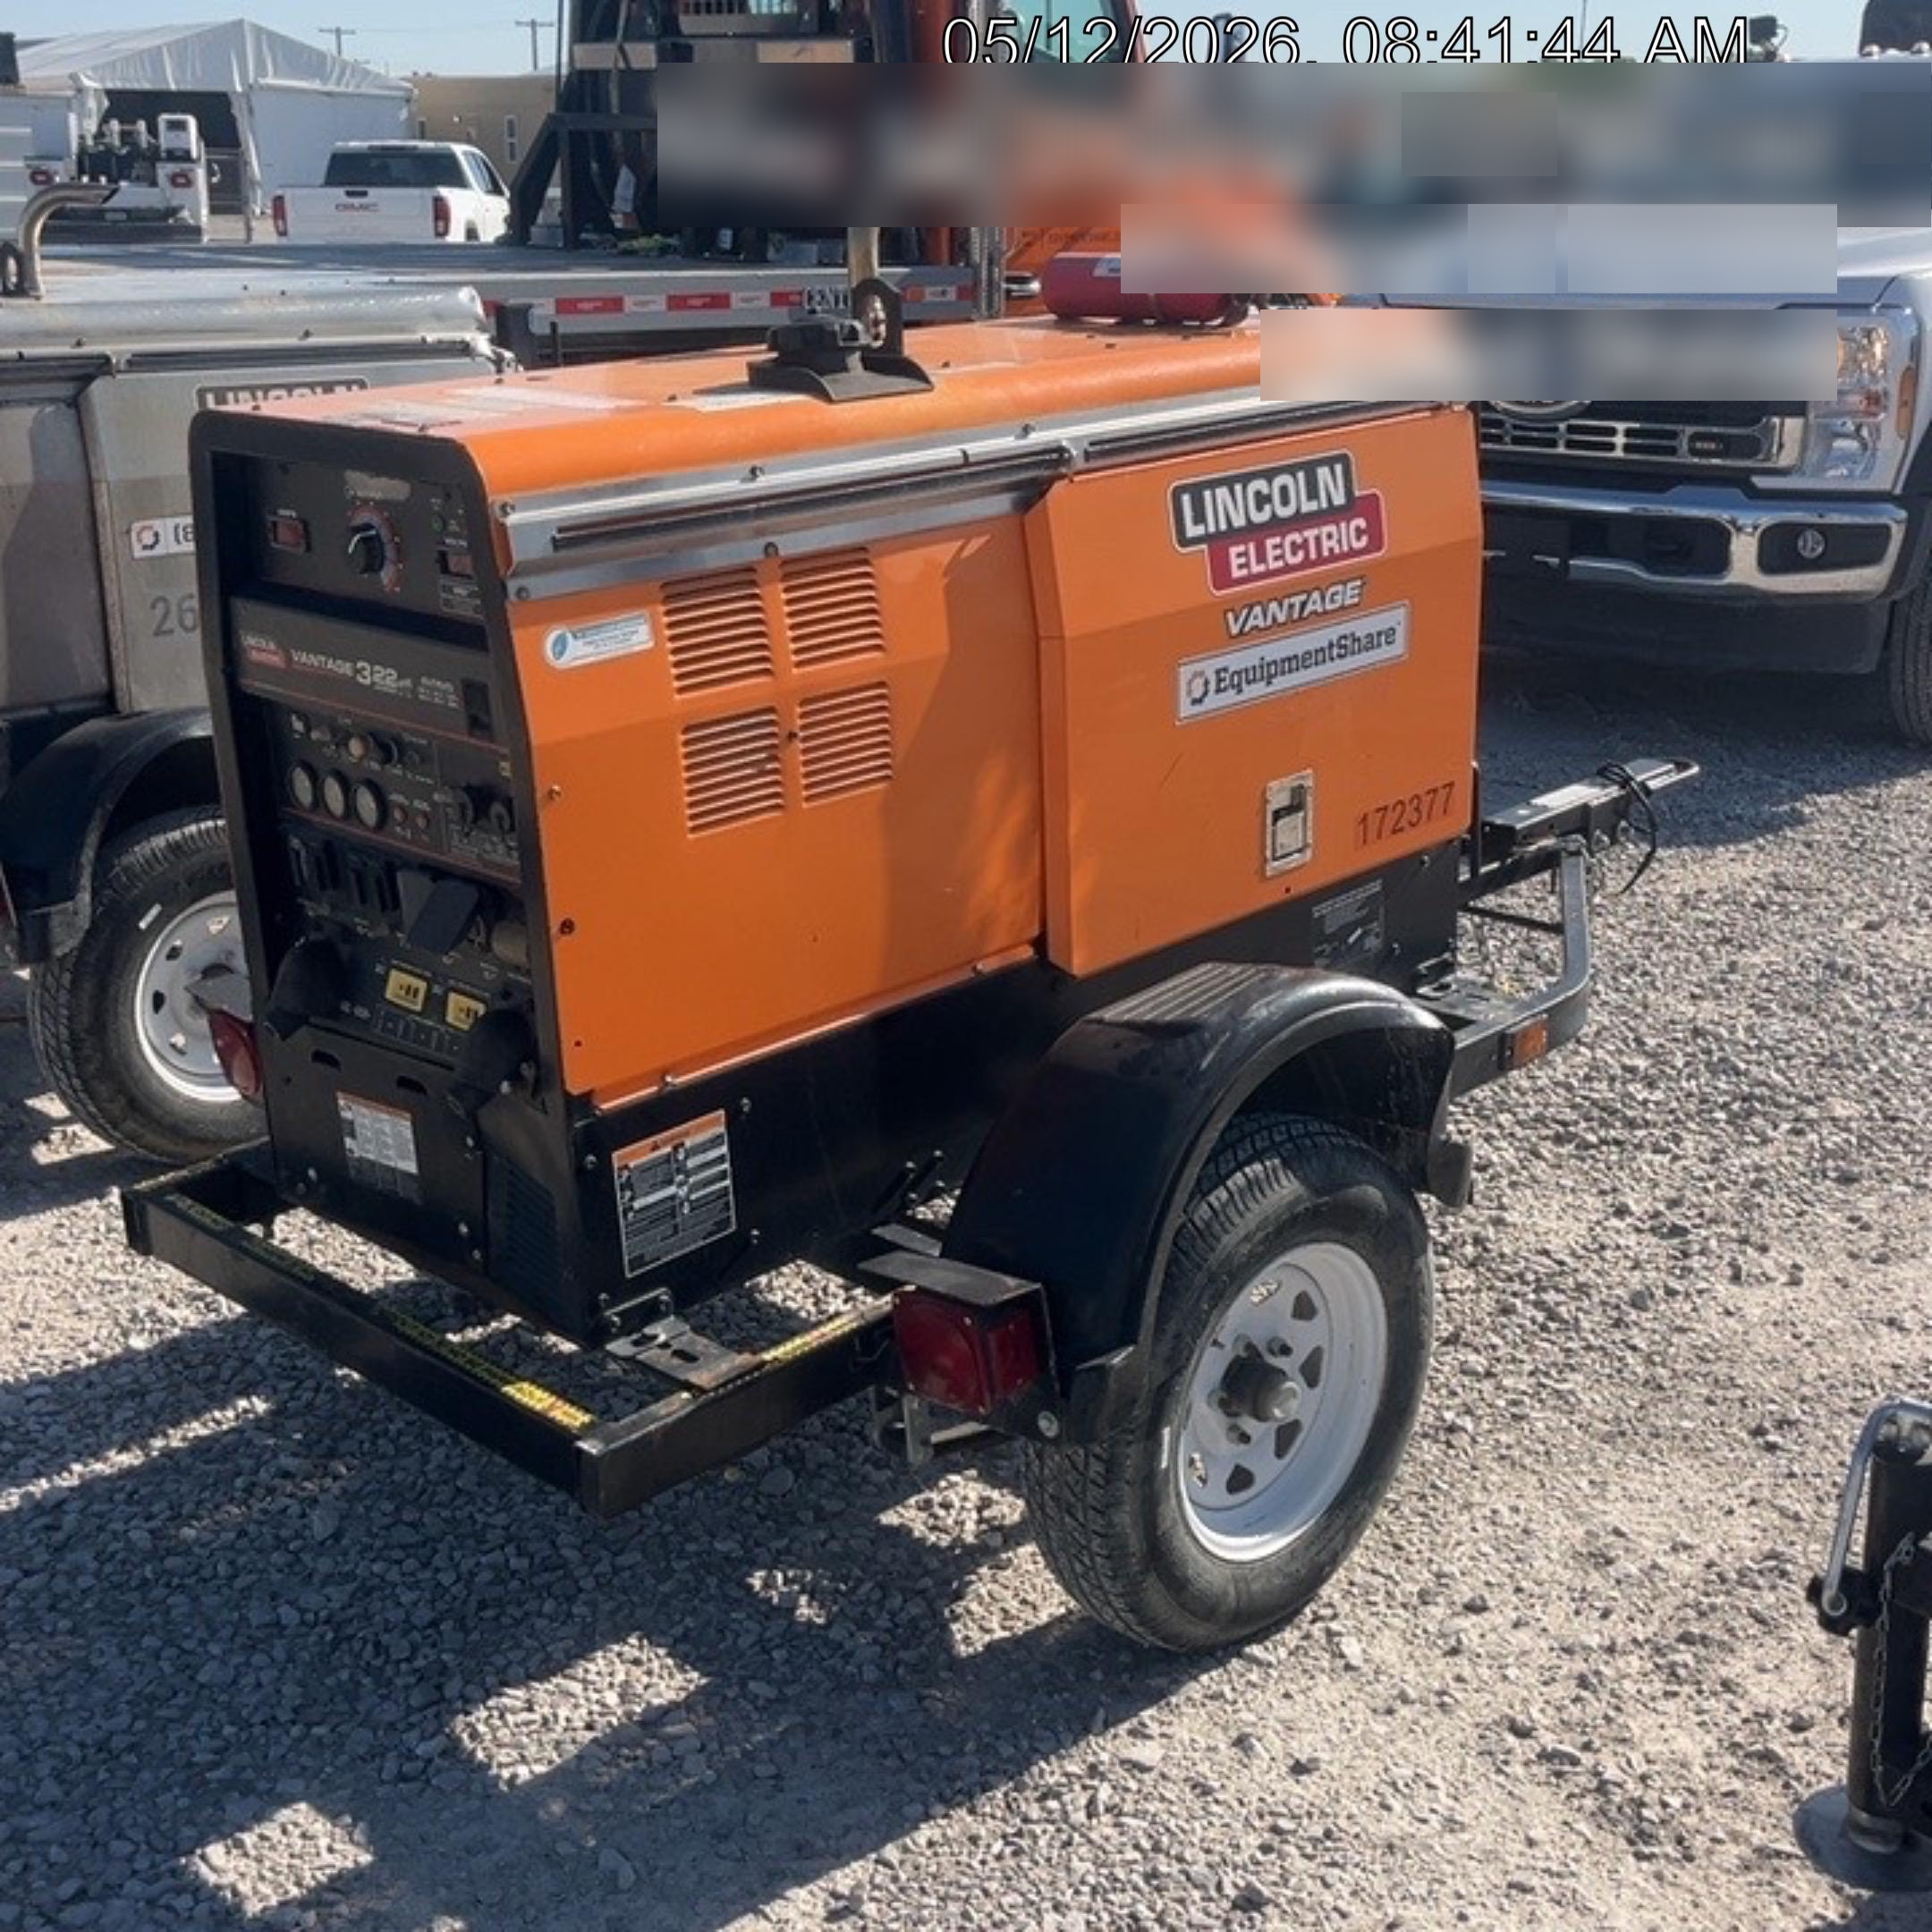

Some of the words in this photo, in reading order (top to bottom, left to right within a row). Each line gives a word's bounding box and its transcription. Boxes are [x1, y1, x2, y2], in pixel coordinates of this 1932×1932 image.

[1181, 463, 1347, 538] LINCOLN
[1228, 517, 1369, 580] ELECTRIC
[1224, 578, 1364, 638] VANTAGE
[1214, 626, 1397, 695] EquipmentShare
[1358, 780, 1455, 845] 172377
